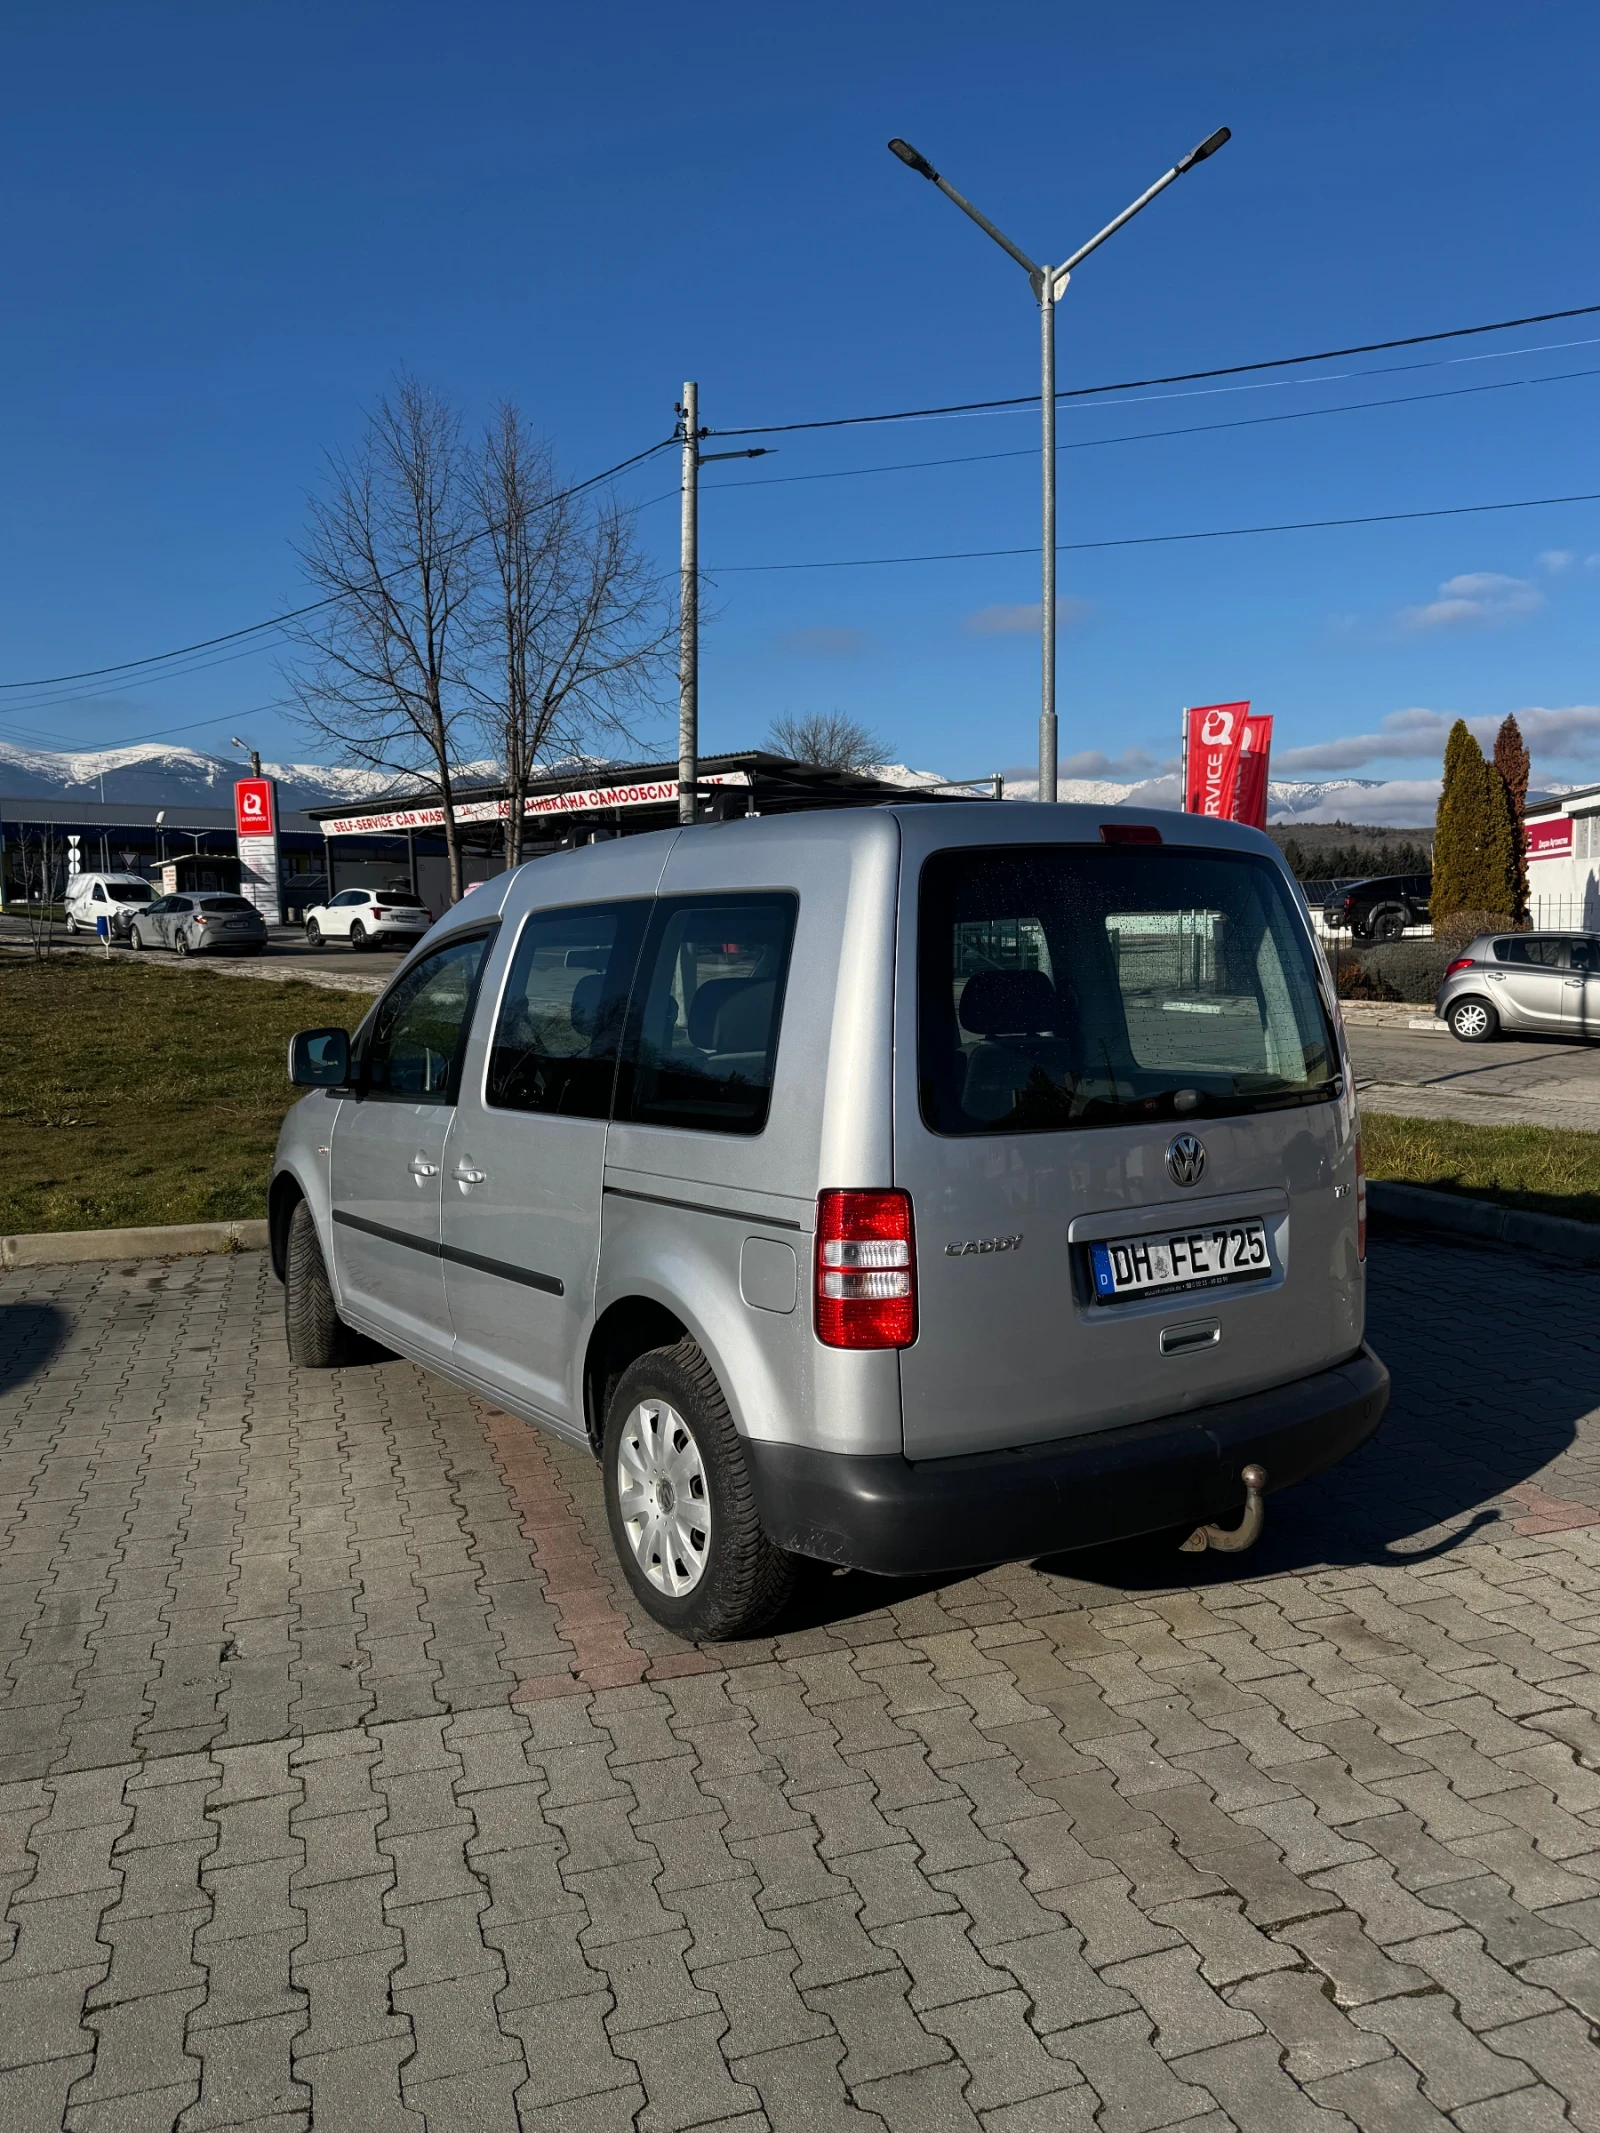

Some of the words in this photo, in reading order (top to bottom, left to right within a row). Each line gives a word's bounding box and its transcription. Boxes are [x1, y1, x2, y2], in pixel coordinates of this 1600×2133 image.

[1204, 753, 1224, 819] RVICE
[333, 814, 394, 833] SELF-SERVICE
[396, 811, 417, 828] CAR
[945, 1234, 1024, 1257] CADDY
[1110, 1242, 1153, 1286] DH
[1168, 1234, 1210, 1277] FE
[1212, 1226, 1265, 1269] 725
[1100, 1273, 1109, 1286] D
